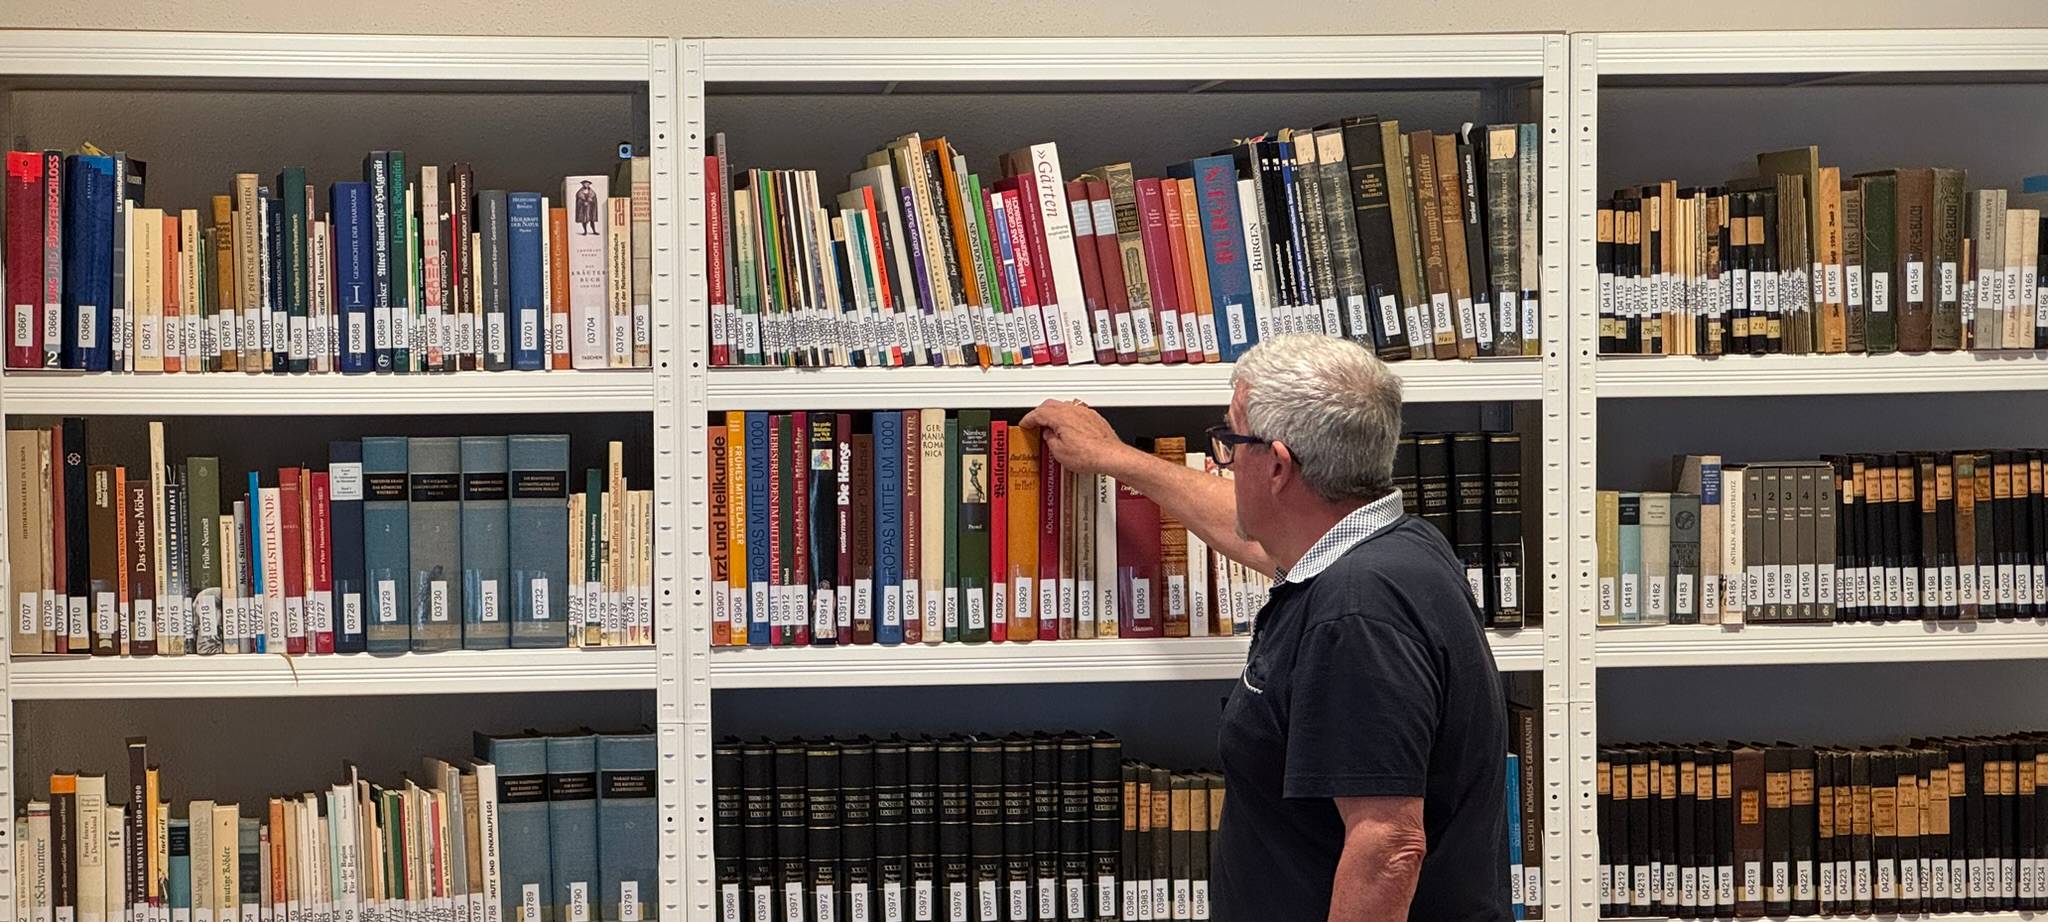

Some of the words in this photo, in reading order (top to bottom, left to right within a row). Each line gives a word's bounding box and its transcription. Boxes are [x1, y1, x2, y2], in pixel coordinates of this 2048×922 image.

[49, 155, 60, 249] FÜRSTENSCHLOSS
[711, 191, 719, 239] MITTELEUROPAS
[351, 226, 359, 238] DER
[968, 221, 981, 261] SOLINGEN
[975, 262, 984, 272] IN
[377, 283, 387, 308] enker
[1603, 282, 1611, 308] 04114
[1828, 271, 1836, 297] 04155
[1981, 276, 1990, 302] 04162
[18, 312, 26, 339] 03667
[48, 309, 57, 337] 03666
[958, 314, 970, 340] 03873
[1048, 315, 1059, 340] 03881
[1231, 314, 1241, 339] 03890
[1353, 305, 1363, 330] 03898
[1436, 302, 1446, 328] 03902
[1479, 312, 1487, 338] 03904
[124, 322, 133, 348] 03670
[167, 323, 175, 350] 03672
[247, 319, 255, 346] 03680
[294, 328, 302, 355] 03683
[395, 318, 403, 346] 03690
[461, 324, 469, 350] 03698
[555, 324, 563, 350] 03703
[616, 326, 624, 353] 03705
[1100, 319, 1109, 344] 03884
[1166, 321, 1176, 346] 03887
[47, 351, 58, 366] 2
[751, 420, 764, 450] 1000
[881, 420, 895, 450] 1000
[926, 424, 941, 432] GER
[923, 441, 944, 449] ROMA
[751, 457, 765, 479] UM
[770, 428, 778, 503] LIEBESFREUDEN
[838, 441, 851, 482] Hanse
[881, 457, 895, 479] UM
[712, 436, 726, 517] Heilkunde
[135, 488, 145, 519] Möbel
[751, 484, 765, 525] MITTE
[838, 483, 849, 505] Die
[882, 484, 895, 524] MITTE
[1752, 493, 1757, 501] 1
[1768, 492, 1775, 501] 2
[1785, 492, 1792, 500] 3
[1802, 492, 1809, 500] 4
[1821, 492, 1828, 500] 5
[169, 489, 177, 533] KEMENATE
[735, 483, 744, 545] MITTELALTER
[771, 505, 778, 518] IM
[135, 520, 146, 552] schöne
[202, 518, 210, 547] Neuzeit
[713, 521, 727, 551] und
[169, 540, 177, 570] KELLER
[202, 548, 210, 569] Frühe
[267, 494, 279, 599] MÖBELSTILKUNDE
[771, 520, 779, 585] MITTELALTER
[136, 554, 146, 573] Das
[1504, 577, 1512, 602] 03968
[1767, 572, 1775, 598] 04188
[1873, 575, 1881, 601] 04195
[1928, 576, 1936, 601] 04198
[1964, 574, 1972, 599] 04200
[2018, 574, 2026, 599] 04203
[434, 590, 442, 617] 03730
[535, 589, 543, 616] 03732
[716, 591, 724, 617] 03907
[756, 591, 764, 618] 03909
[839, 595, 847, 621] 03915
[887, 595, 895, 621] 03920
[971, 598, 980, 624] 03925
[1019, 587, 1027, 613] 03929
[1082, 590, 1090, 616] 03933
[1137, 588, 1145, 614] 03935
[1219, 588, 1228, 614] 03939
[22, 604, 31, 630] 03707
[100, 604, 108, 630] 03711
[170, 606, 179, 632] 03715
[270, 611, 279, 638] 03723
[317, 602, 326, 628] 03727
[487, 801, 495, 857] DENKMALPFLEGE
[1512, 873, 1520, 899] 04009
[1800, 869, 1808, 894] 04221
[1859, 868, 1867, 893] 04224
[1905, 867, 1913, 892] 04226
[1973, 866, 1981, 892] 04230
[526, 892, 534, 918] 03789
[727, 893, 735, 919] 03969
[789, 893, 798, 918] 03971
[888, 892, 896, 918] 03974
[1126, 890, 1134, 916] 03982
